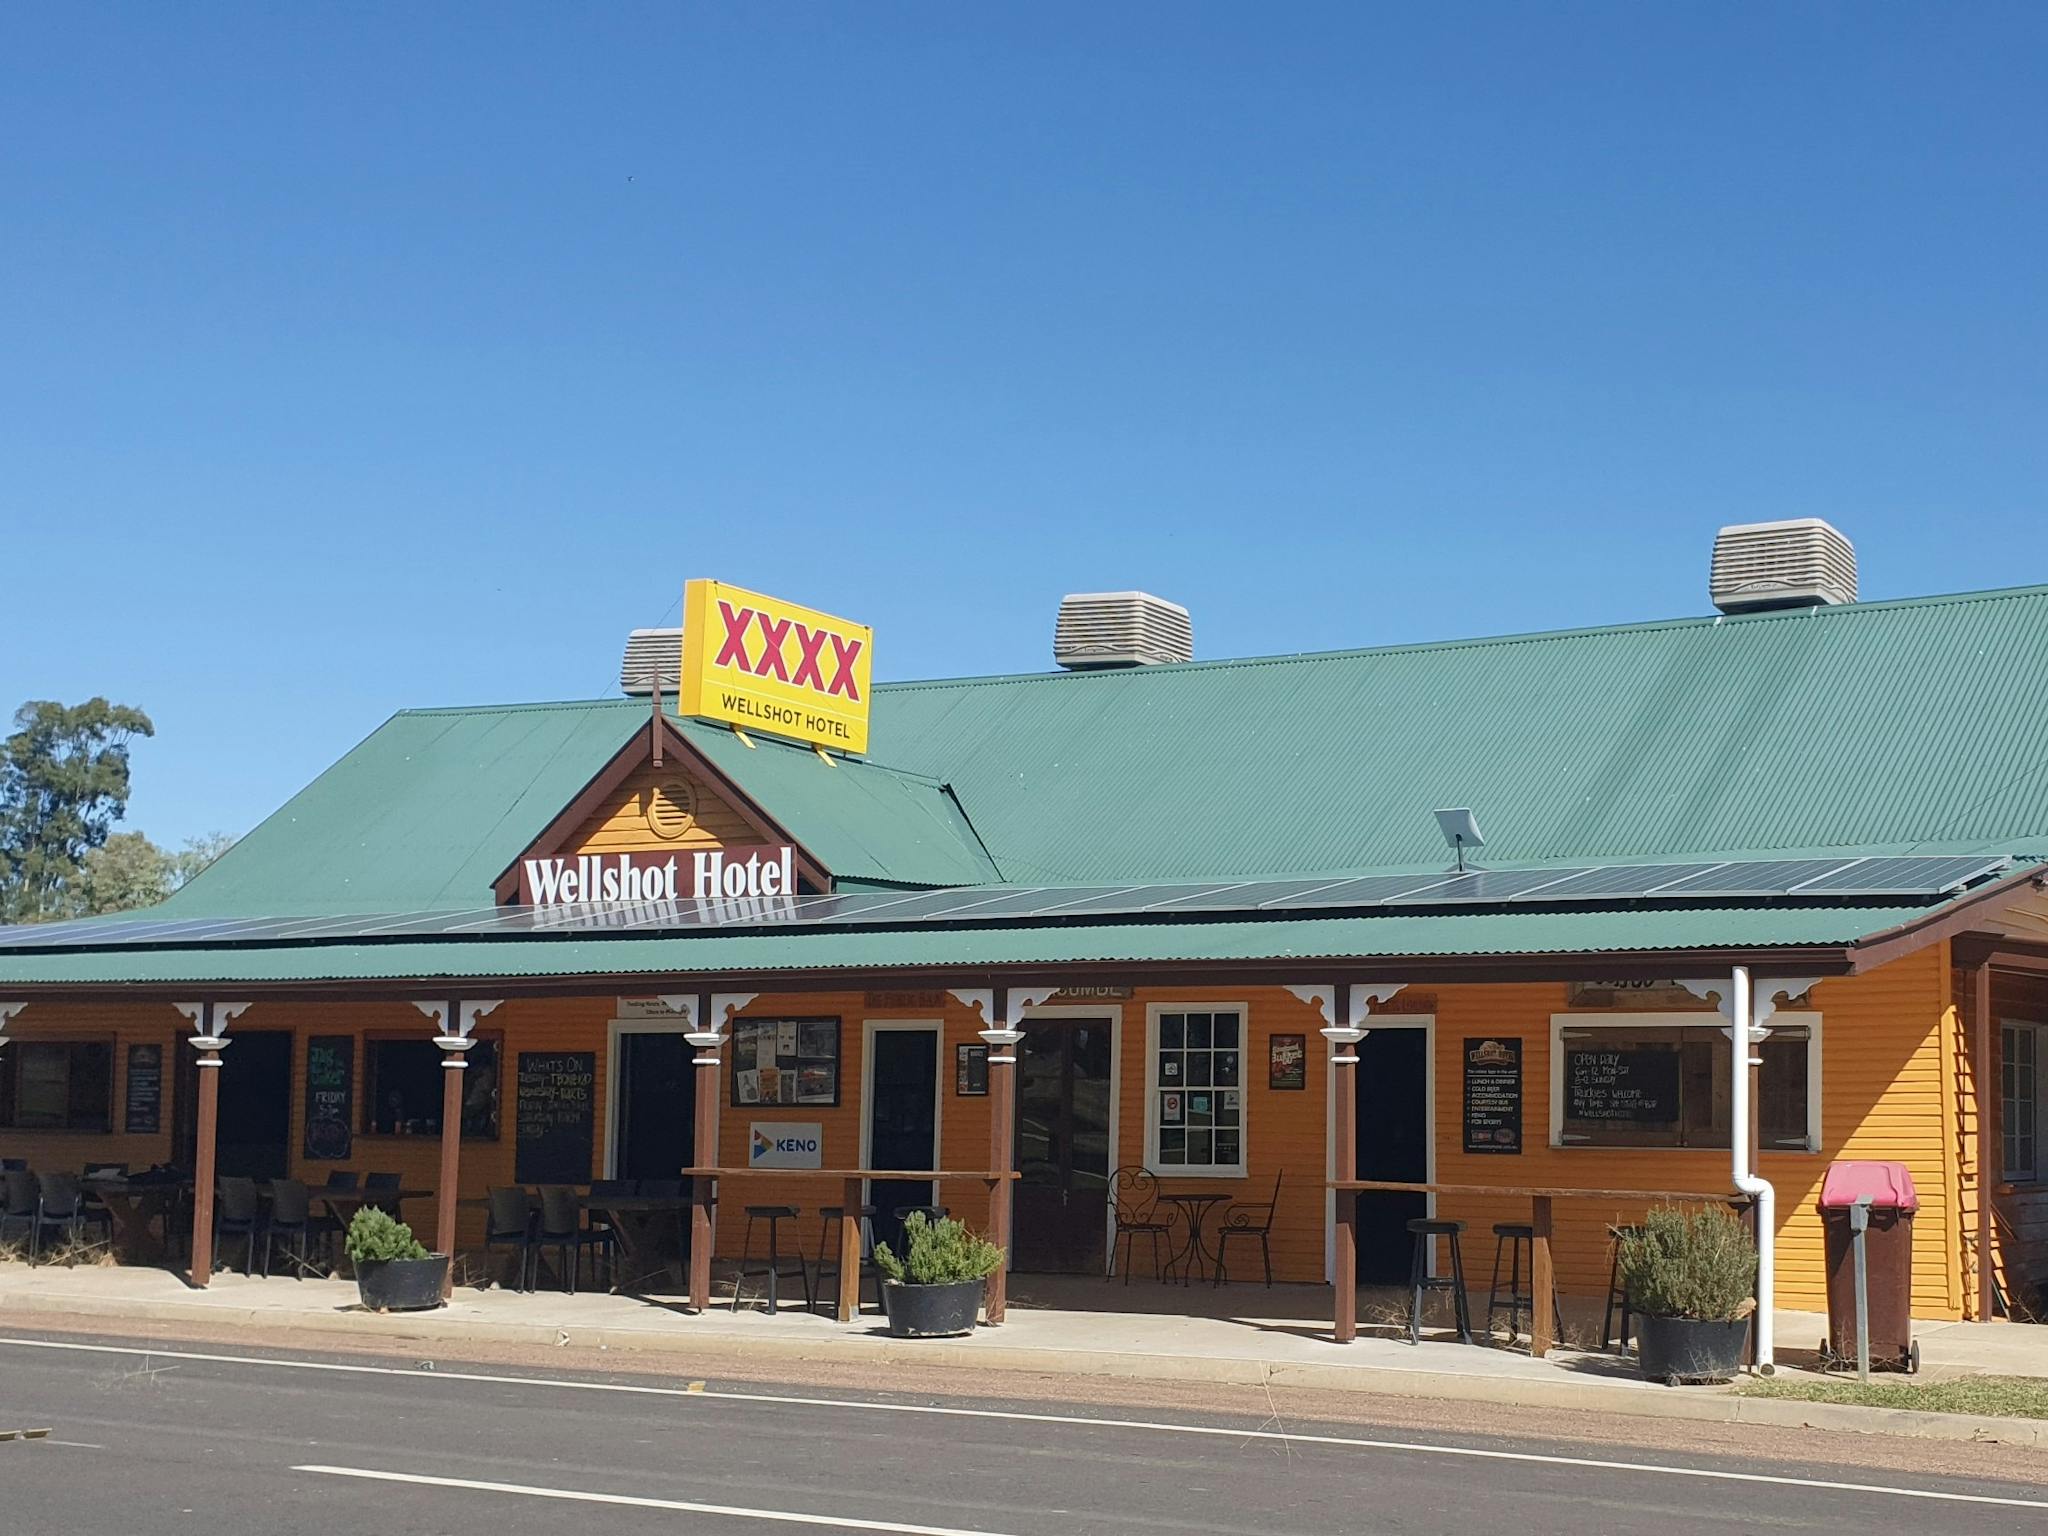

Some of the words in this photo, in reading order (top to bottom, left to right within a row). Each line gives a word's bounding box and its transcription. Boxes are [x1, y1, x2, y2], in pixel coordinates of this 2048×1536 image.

[714, 599, 862, 703] XXXX
[721, 692, 802, 727] WELLSHOT
[806, 714, 851, 739] HOTEL
[524, 853, 679, 906] Wellshot
[693, 846, 793, 899] Hotel
[566, 1056, 585, 1073] ON
[1575, 1054, 1597, 1065] OPEN
[315, 1091, 345, 1104] FRIDAY
[777, 1138, 817, 1152] KENO
